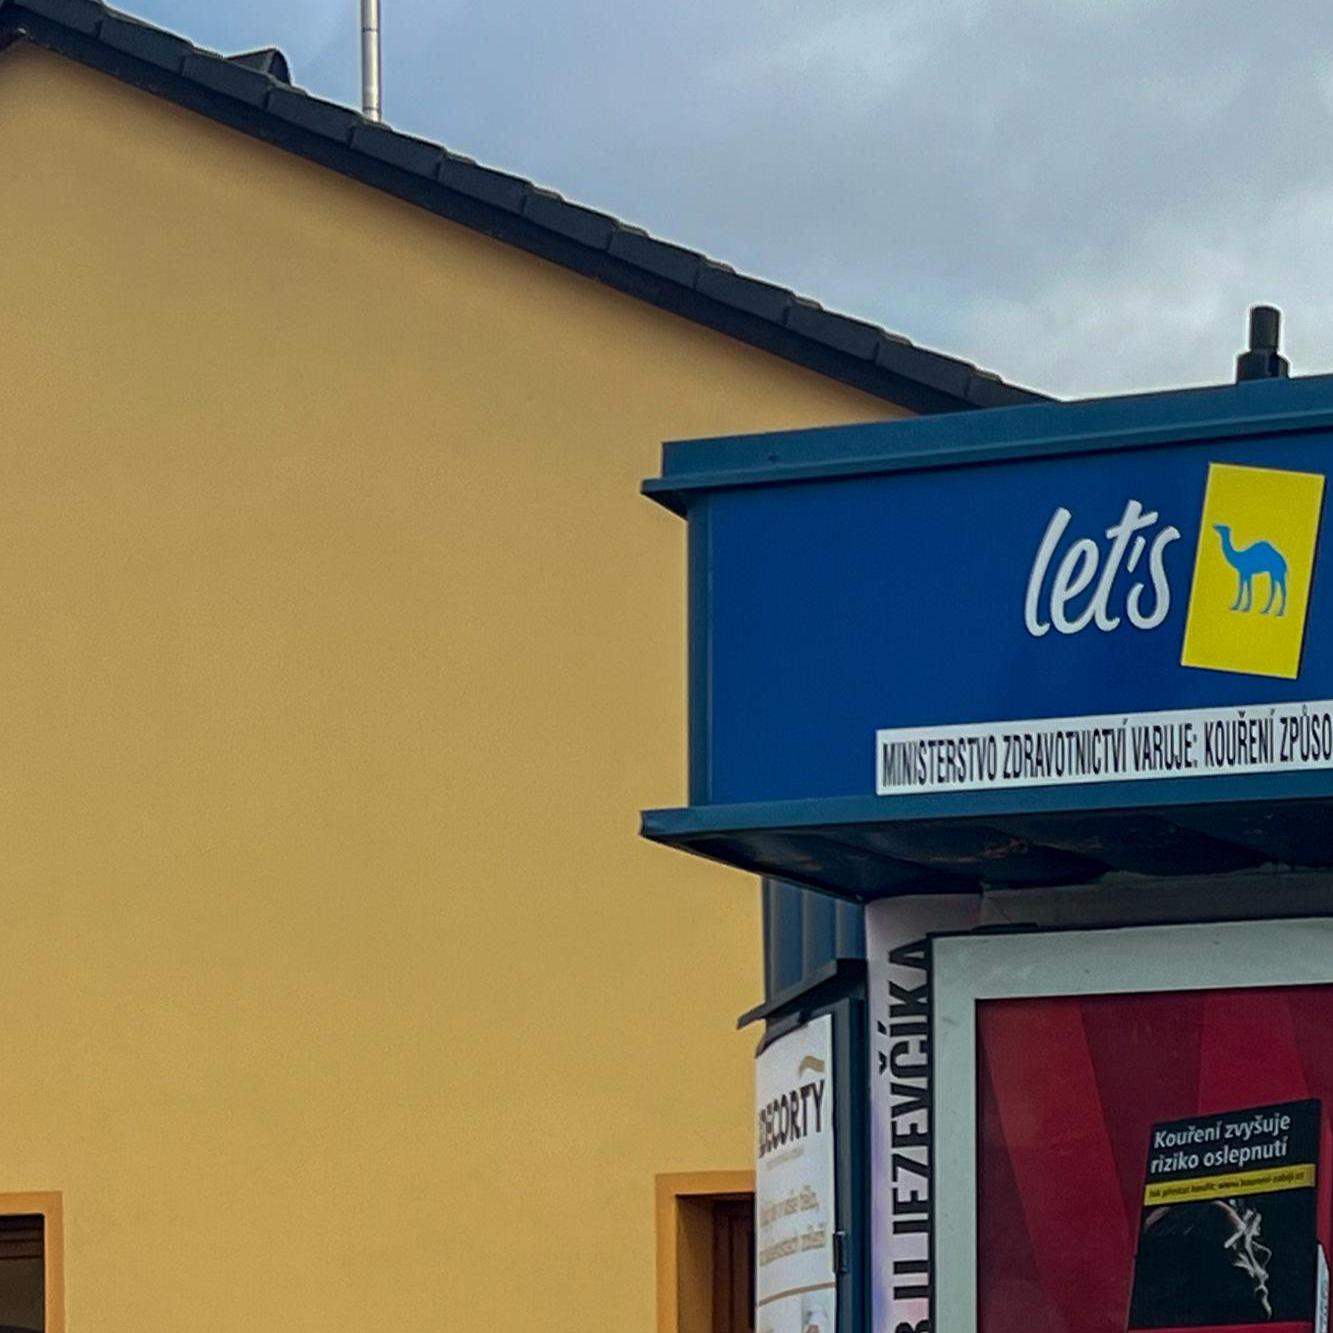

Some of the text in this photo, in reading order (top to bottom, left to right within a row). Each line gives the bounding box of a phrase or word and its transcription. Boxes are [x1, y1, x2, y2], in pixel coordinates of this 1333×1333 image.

[1024, 499, 1182, 637] let's
[883, 733, 998, 788] MINISTERSTVO
[1002, 717, 1126, 780] ZDRAVOTNICTVÍ
[1131, 720, 1197, 773] VARUJE:
[1203, 706, 1275, 767] KOUŘENÍ
[1151, 1136, 1289, 1174] riziko oslepnutí
[1154, 1113, 1291, 1149] Kouření zvyšuje
